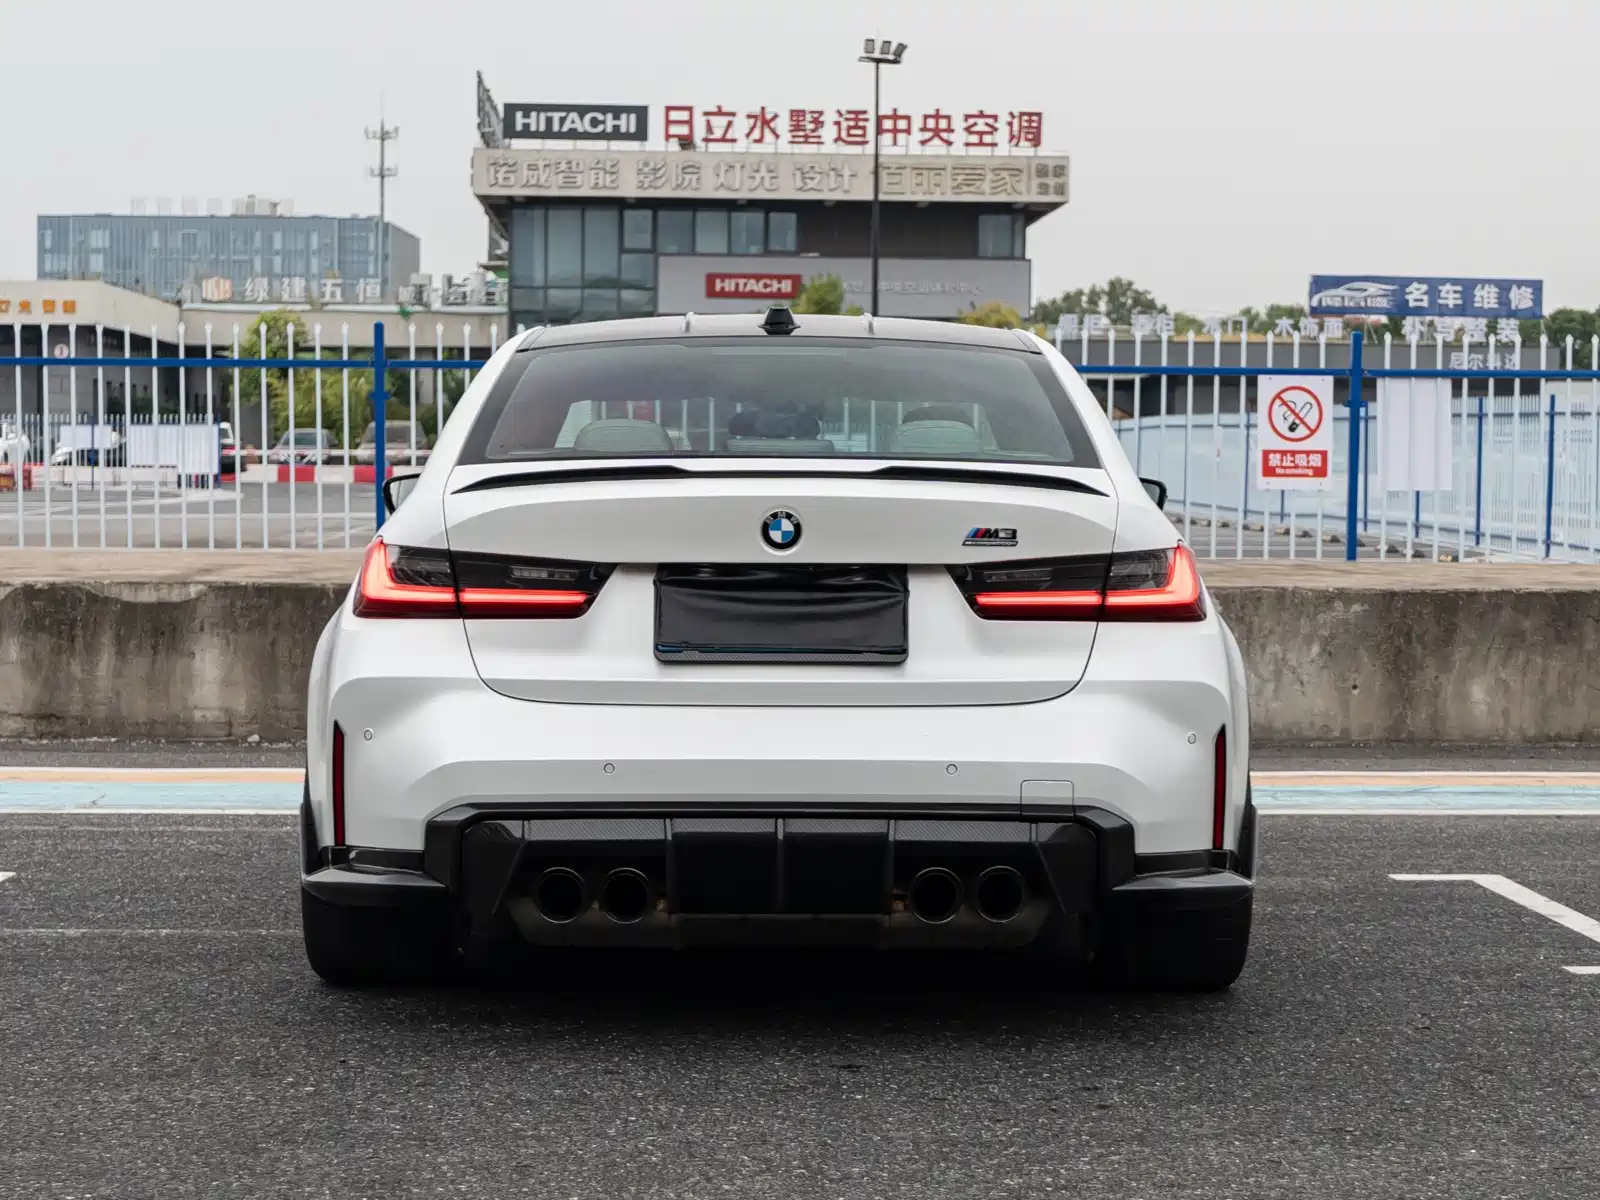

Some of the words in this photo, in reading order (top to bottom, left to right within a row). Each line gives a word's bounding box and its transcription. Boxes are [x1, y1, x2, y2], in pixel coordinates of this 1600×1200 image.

[514, 110, 637, 133] HITACHI
[664, 105, 1042, 148] 日立水墅适中央空调
[636, 158, 702, 192] 影院
[712, 159, 781, 193] 灯光
[791, 161, 858, 195] 设计
[714, 277, 793, 293] HITACHI
[1404, 281, 1535, 312] 名车维修
[1268, 453, 1322, 467] 禁止吸烟
